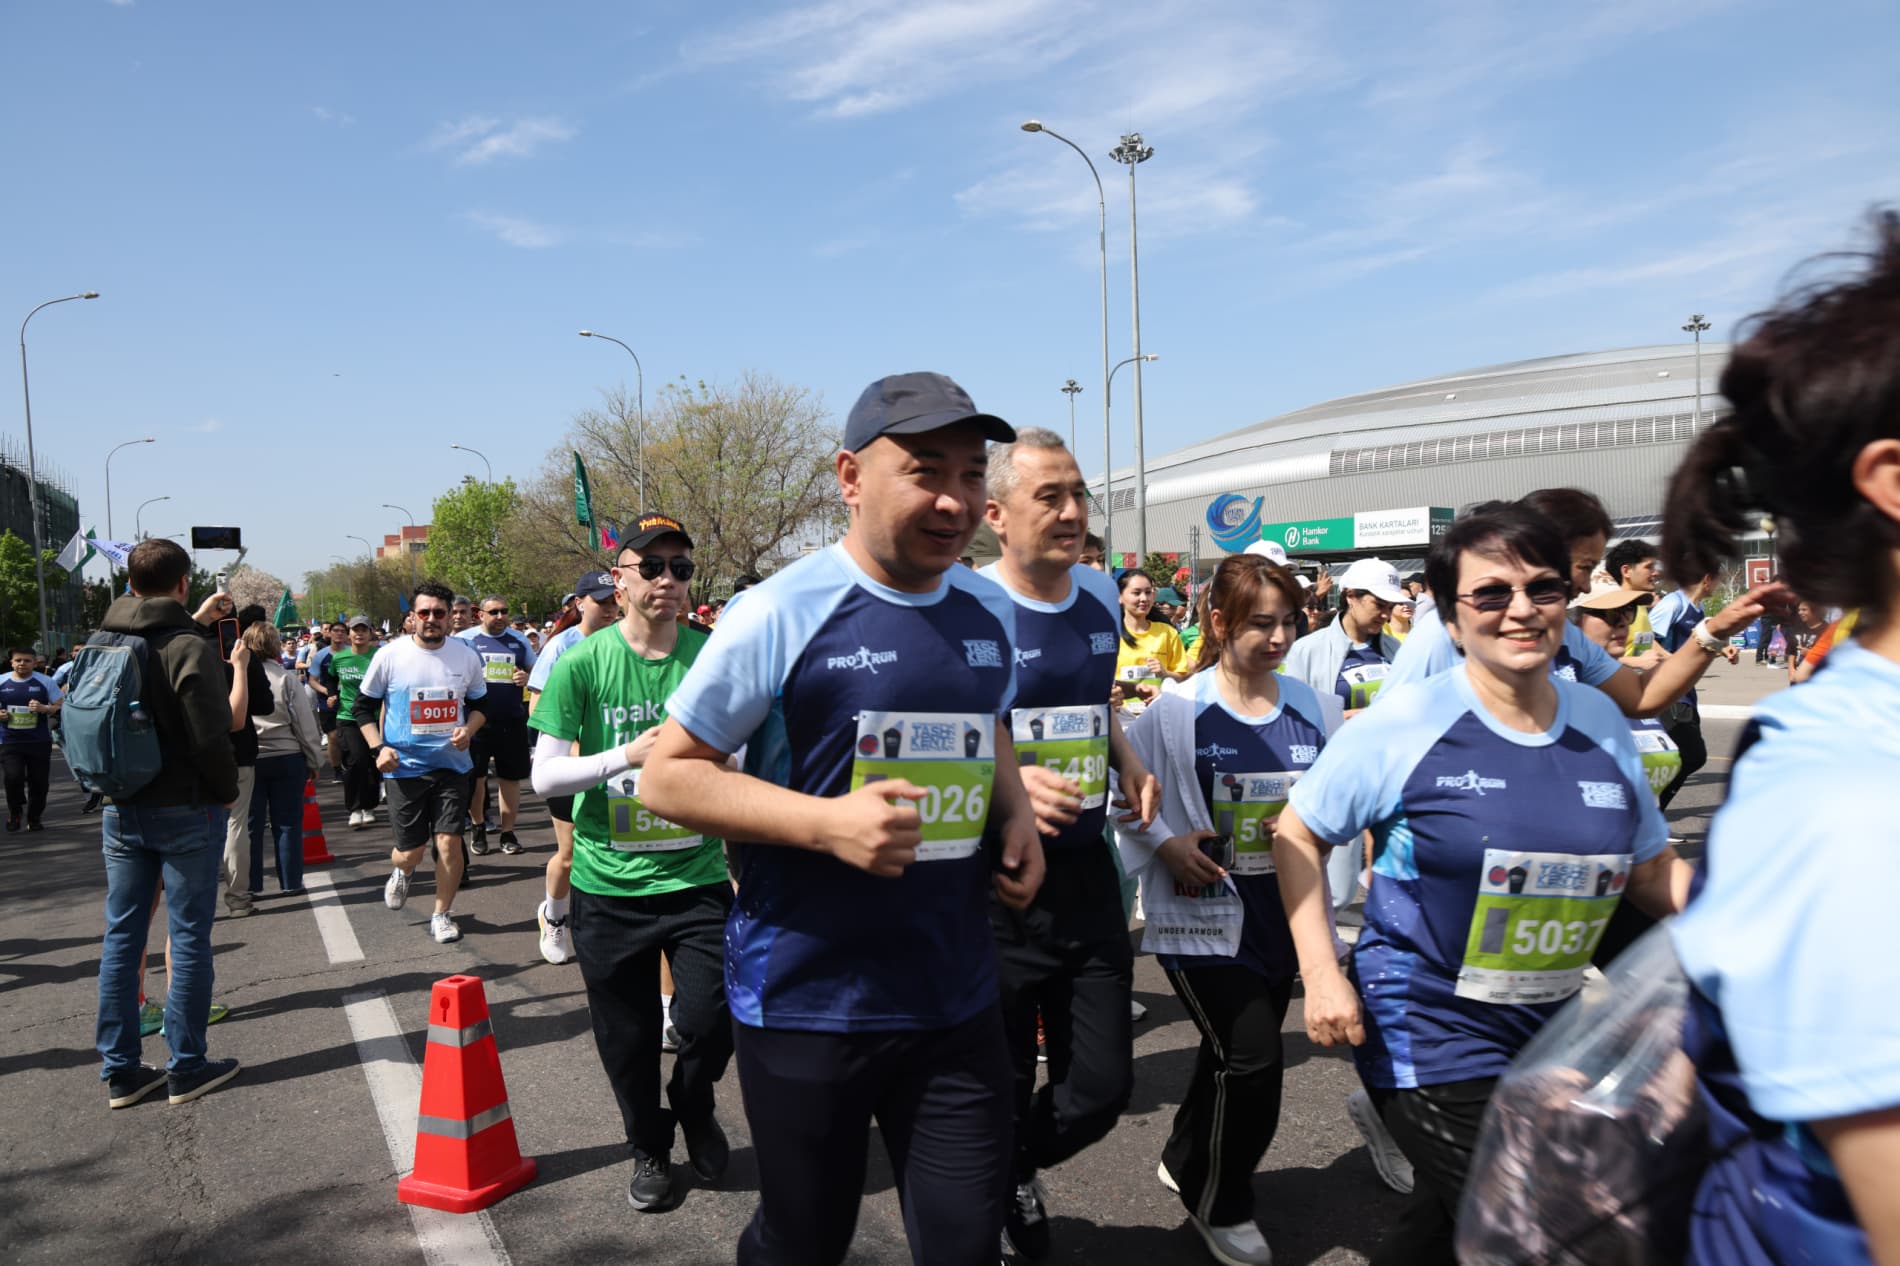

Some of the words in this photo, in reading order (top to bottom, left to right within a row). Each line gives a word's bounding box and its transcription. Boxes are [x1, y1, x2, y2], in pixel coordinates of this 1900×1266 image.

[1302, 526, 1328, 537] Hamkor
[1359, 522, 1378, 531] BANK
[1380, 519, 1419, 528] KARTALARI
[1302, 536, 1320, 546] Bank
[827, 655, 856, 669] PRO
[871, 650, 898, 664] RUN
[423, 705, 457, 720] 9019
[602, 699, 662, 730] ipak
[912, 724, 951, 737] TASH
[911, 737, 949, 750] KENT
[896, 784, 985, 823] 026
[1158, 927, 1186, 935] UNDER
[1189, 927, 1224, 937] ARMOUR
[1512, 918, 1606, 954] 5037
